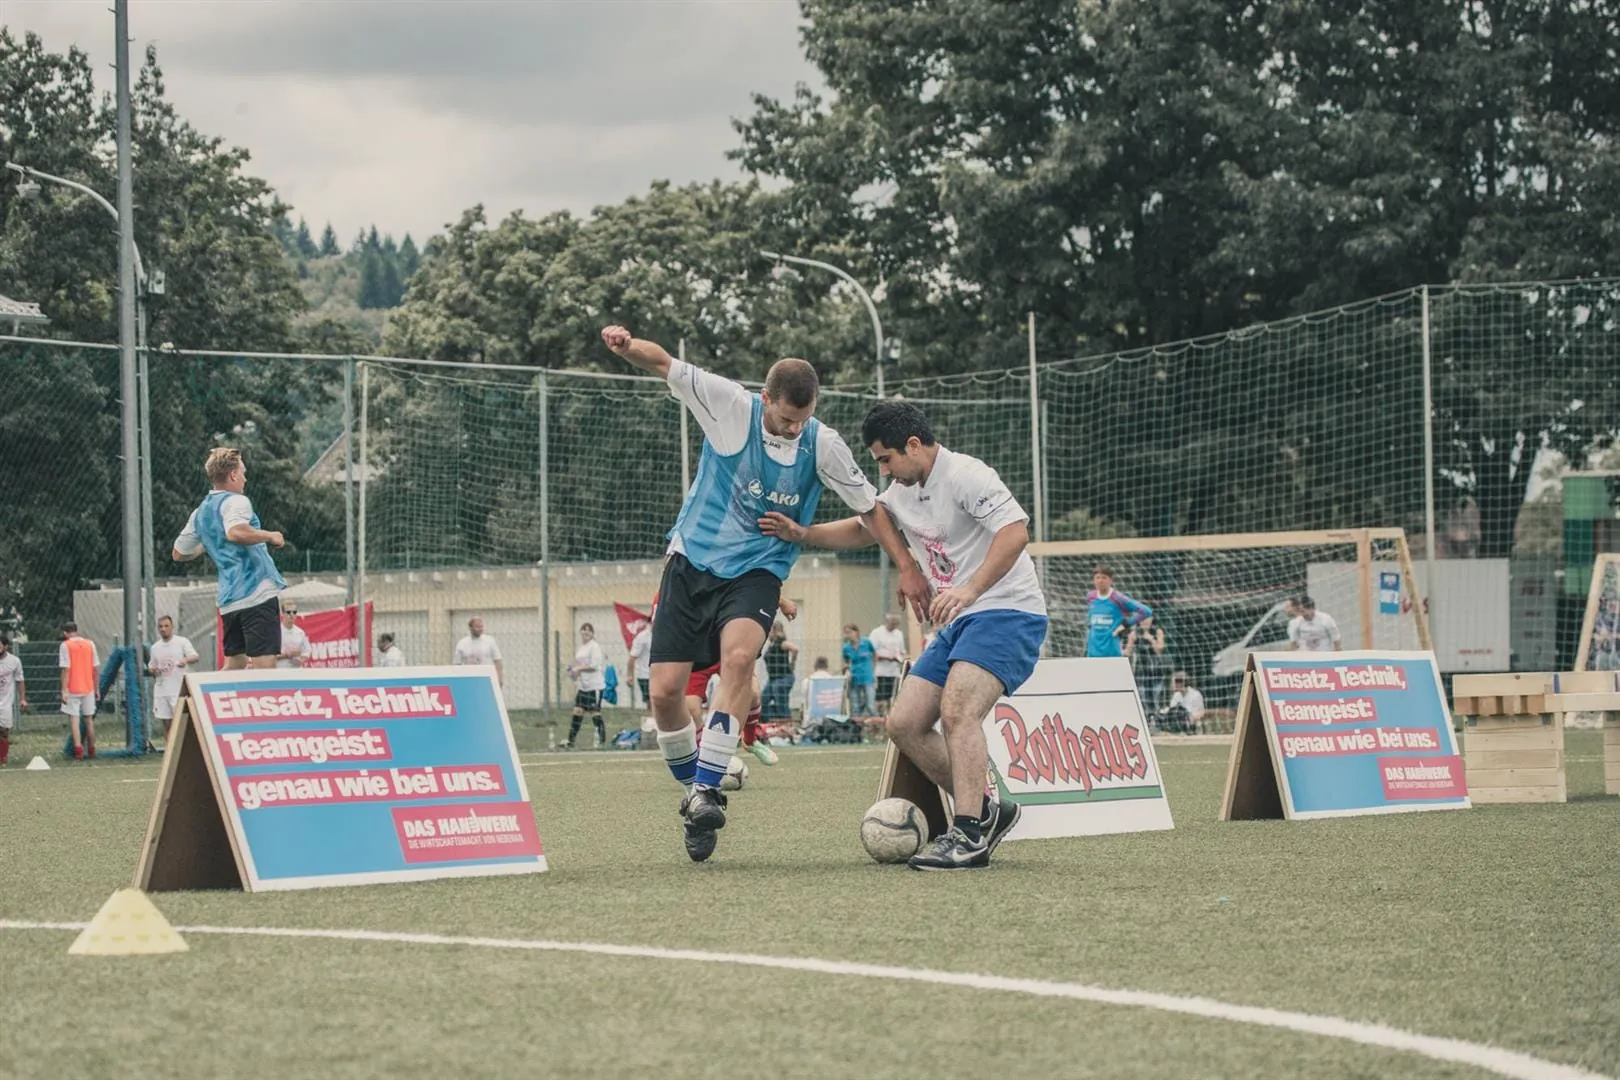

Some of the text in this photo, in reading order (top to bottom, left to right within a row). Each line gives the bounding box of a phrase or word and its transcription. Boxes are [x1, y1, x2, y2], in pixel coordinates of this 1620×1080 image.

[1266, 664, 1406, 691] Einsatz, Technik,
[208, 685, 452, 719] Einsatz, Technik,
[1274, 698, 1373, 725] Teamgeist:
[222, 729, 386, 763] Teamgeist:
[994, 702, 1148, 797] Rothaus
[1282, 727, 1437, 758] genau wie bei uns.
[238, 766, 500, 810] genau wie bei uns.
[1385, 767, 1405, 781] DAS
[402, 809, 520, 838] DAS HANDWERK
